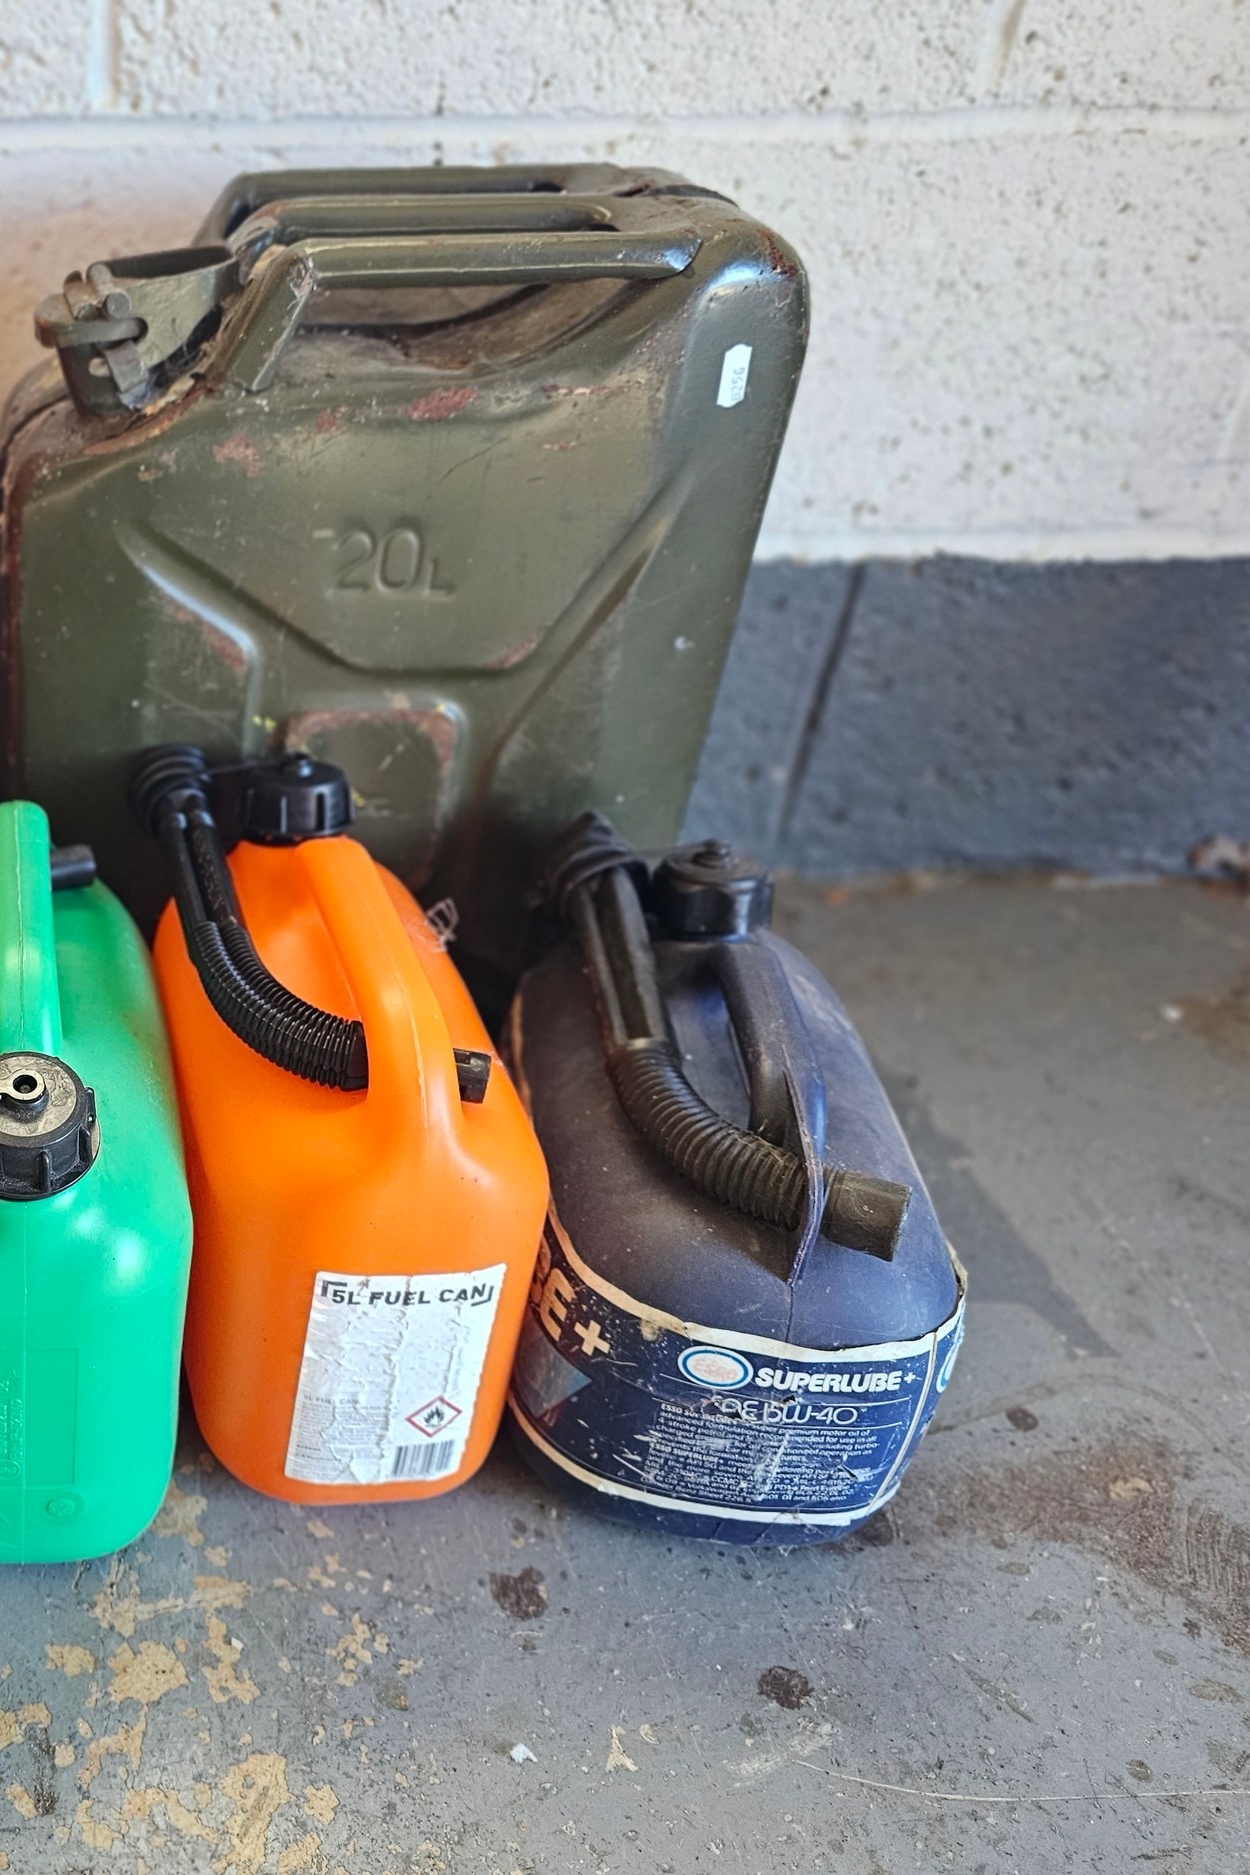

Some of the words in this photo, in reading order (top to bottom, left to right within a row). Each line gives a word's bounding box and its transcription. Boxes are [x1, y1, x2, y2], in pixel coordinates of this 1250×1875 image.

[333, 527, 457, 594] 20L
[330, 1289, 361, 1306] 5L
[368, 1290, 431, 1307] FUEL
[438, 1282, 487, 1304] CAN
[530, 1236, 611, 1357] E+
